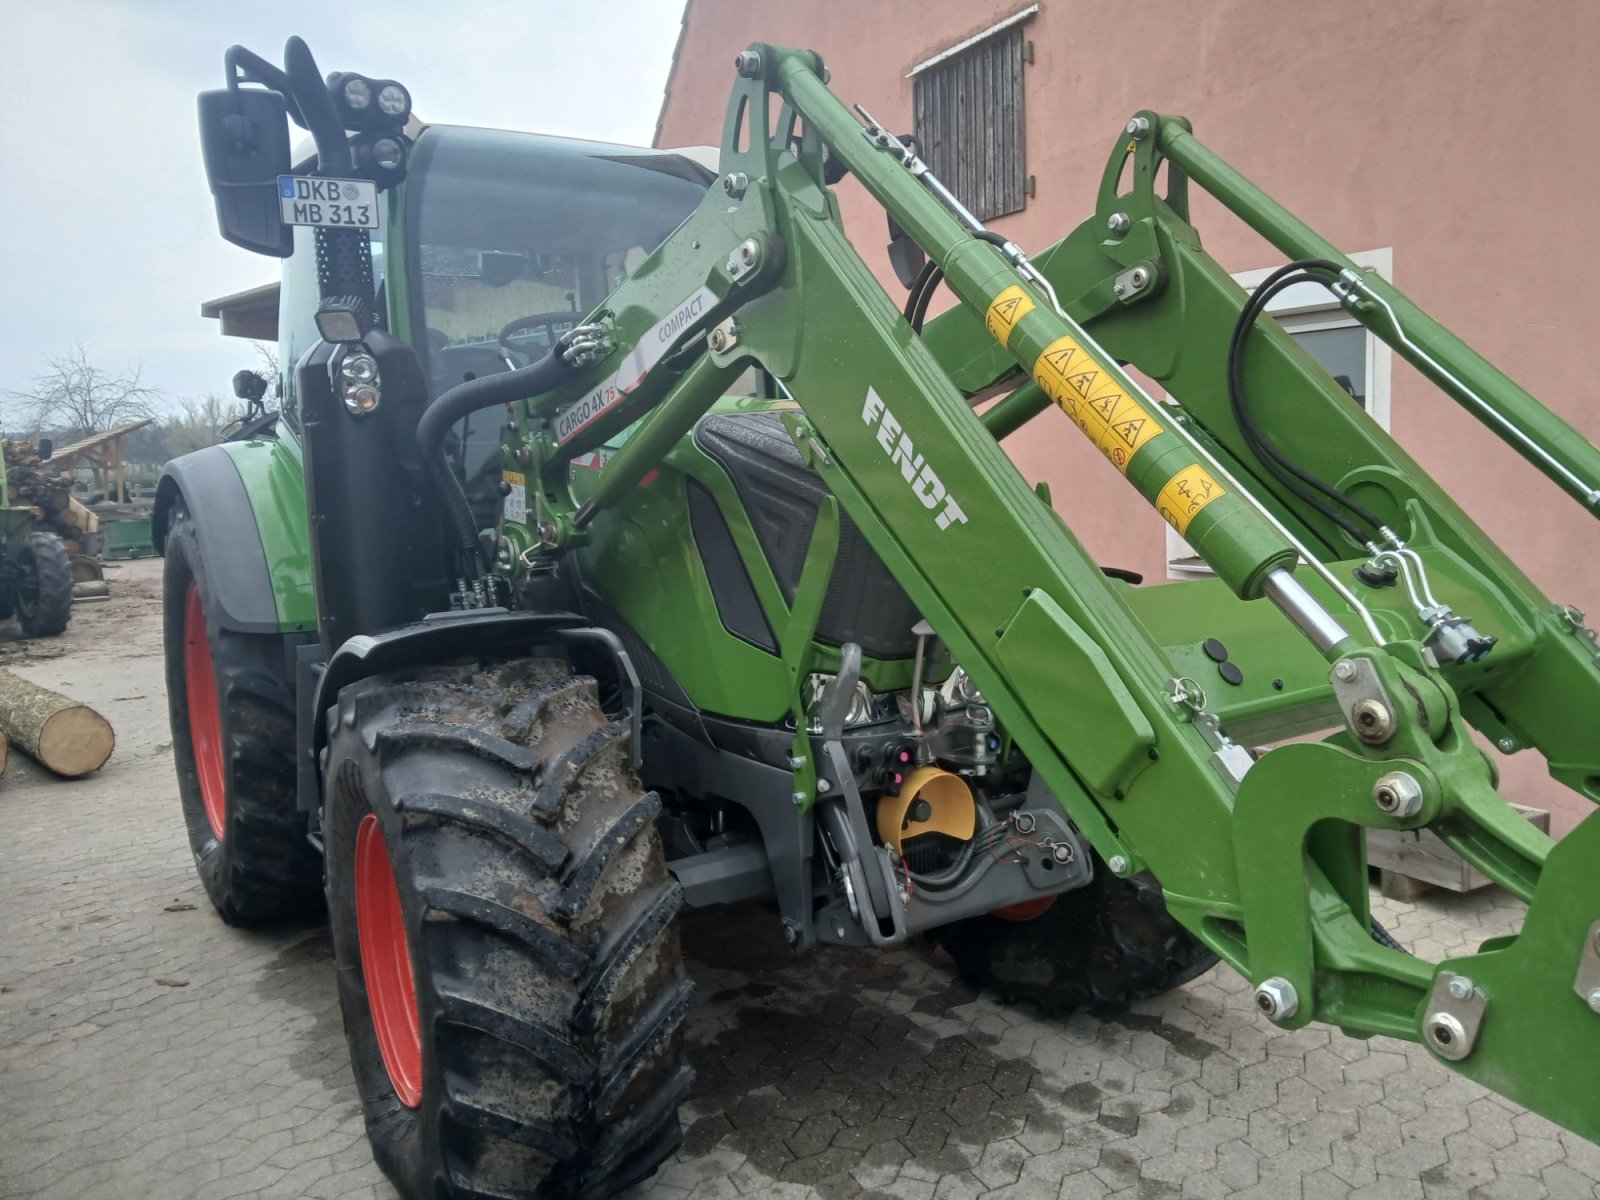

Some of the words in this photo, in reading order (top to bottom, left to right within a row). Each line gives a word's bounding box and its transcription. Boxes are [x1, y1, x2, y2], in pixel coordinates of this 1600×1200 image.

[296, 180, 341, 201] DKB
[293, 202, 322, 223] MB
[329, 204, 369, 225] 313
[658, 295, 703, 343] COMPACT
[559, 401, 591, 437] CARGO
[861, 385, 969, 531] FENDT
